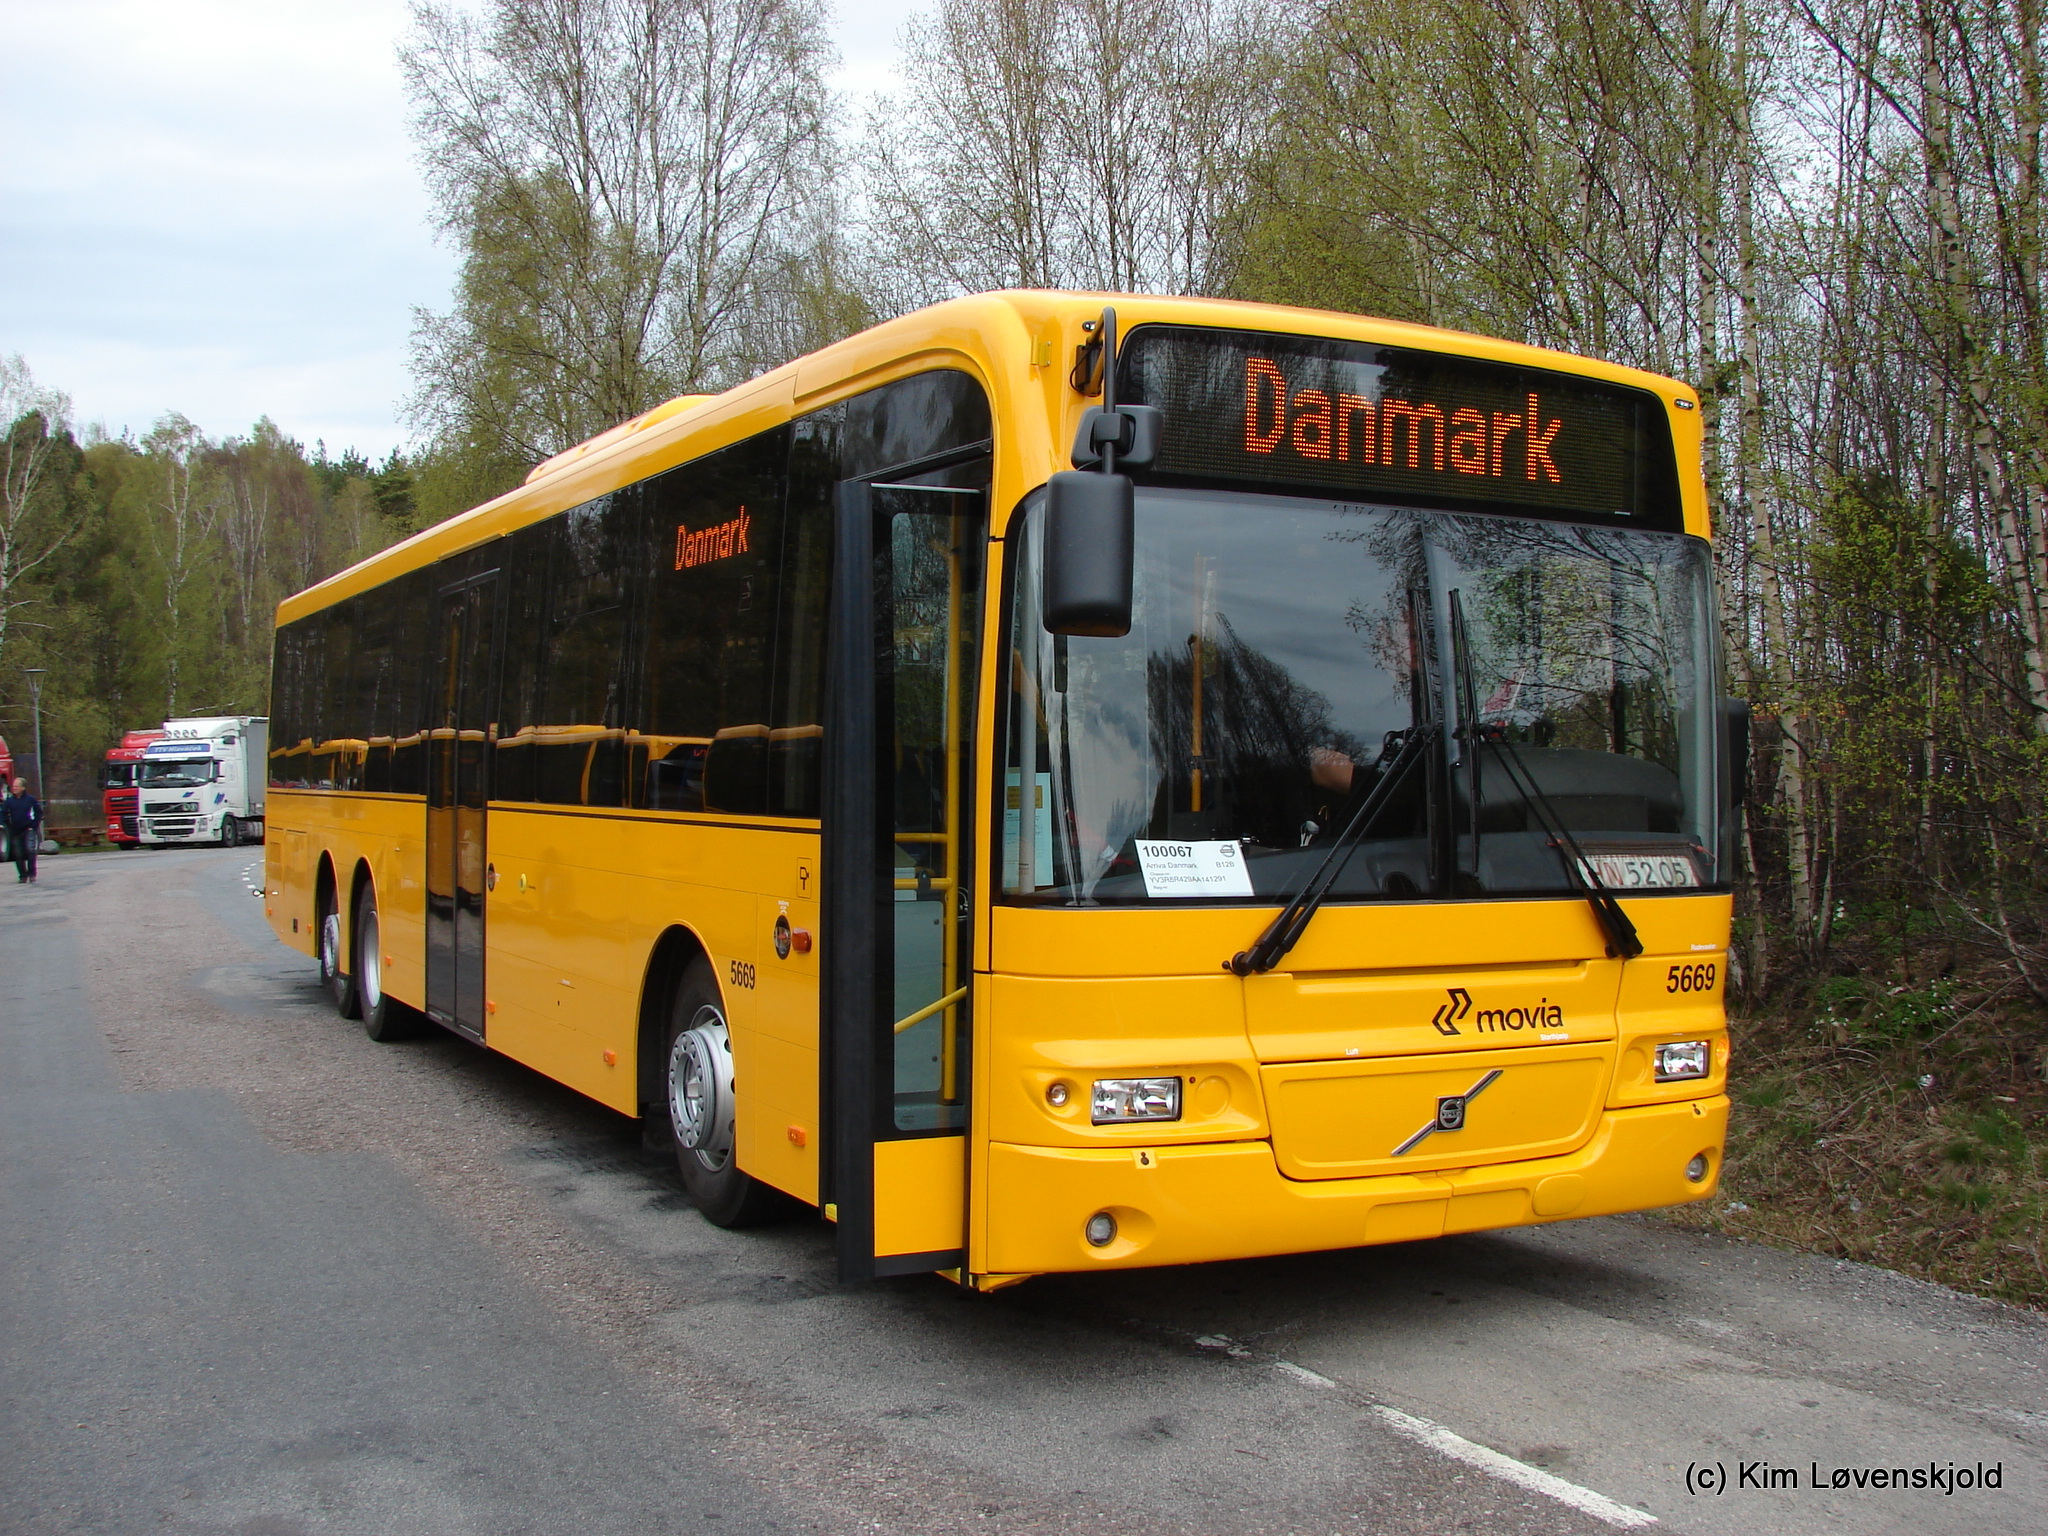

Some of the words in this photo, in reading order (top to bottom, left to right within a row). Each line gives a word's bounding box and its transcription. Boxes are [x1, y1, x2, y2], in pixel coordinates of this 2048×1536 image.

[1245, 357, 1561, 483] Danmark
[675, 505, 750, 571] Danmark
[1142, 845, 1192, 857] 100067
[1167, 861, 1197, 869] Danmark
[730, 960, 756, 990] 5669
[1666, 963, 1716, 993] 5669
[1476, 997, 1563, 1033] movia
